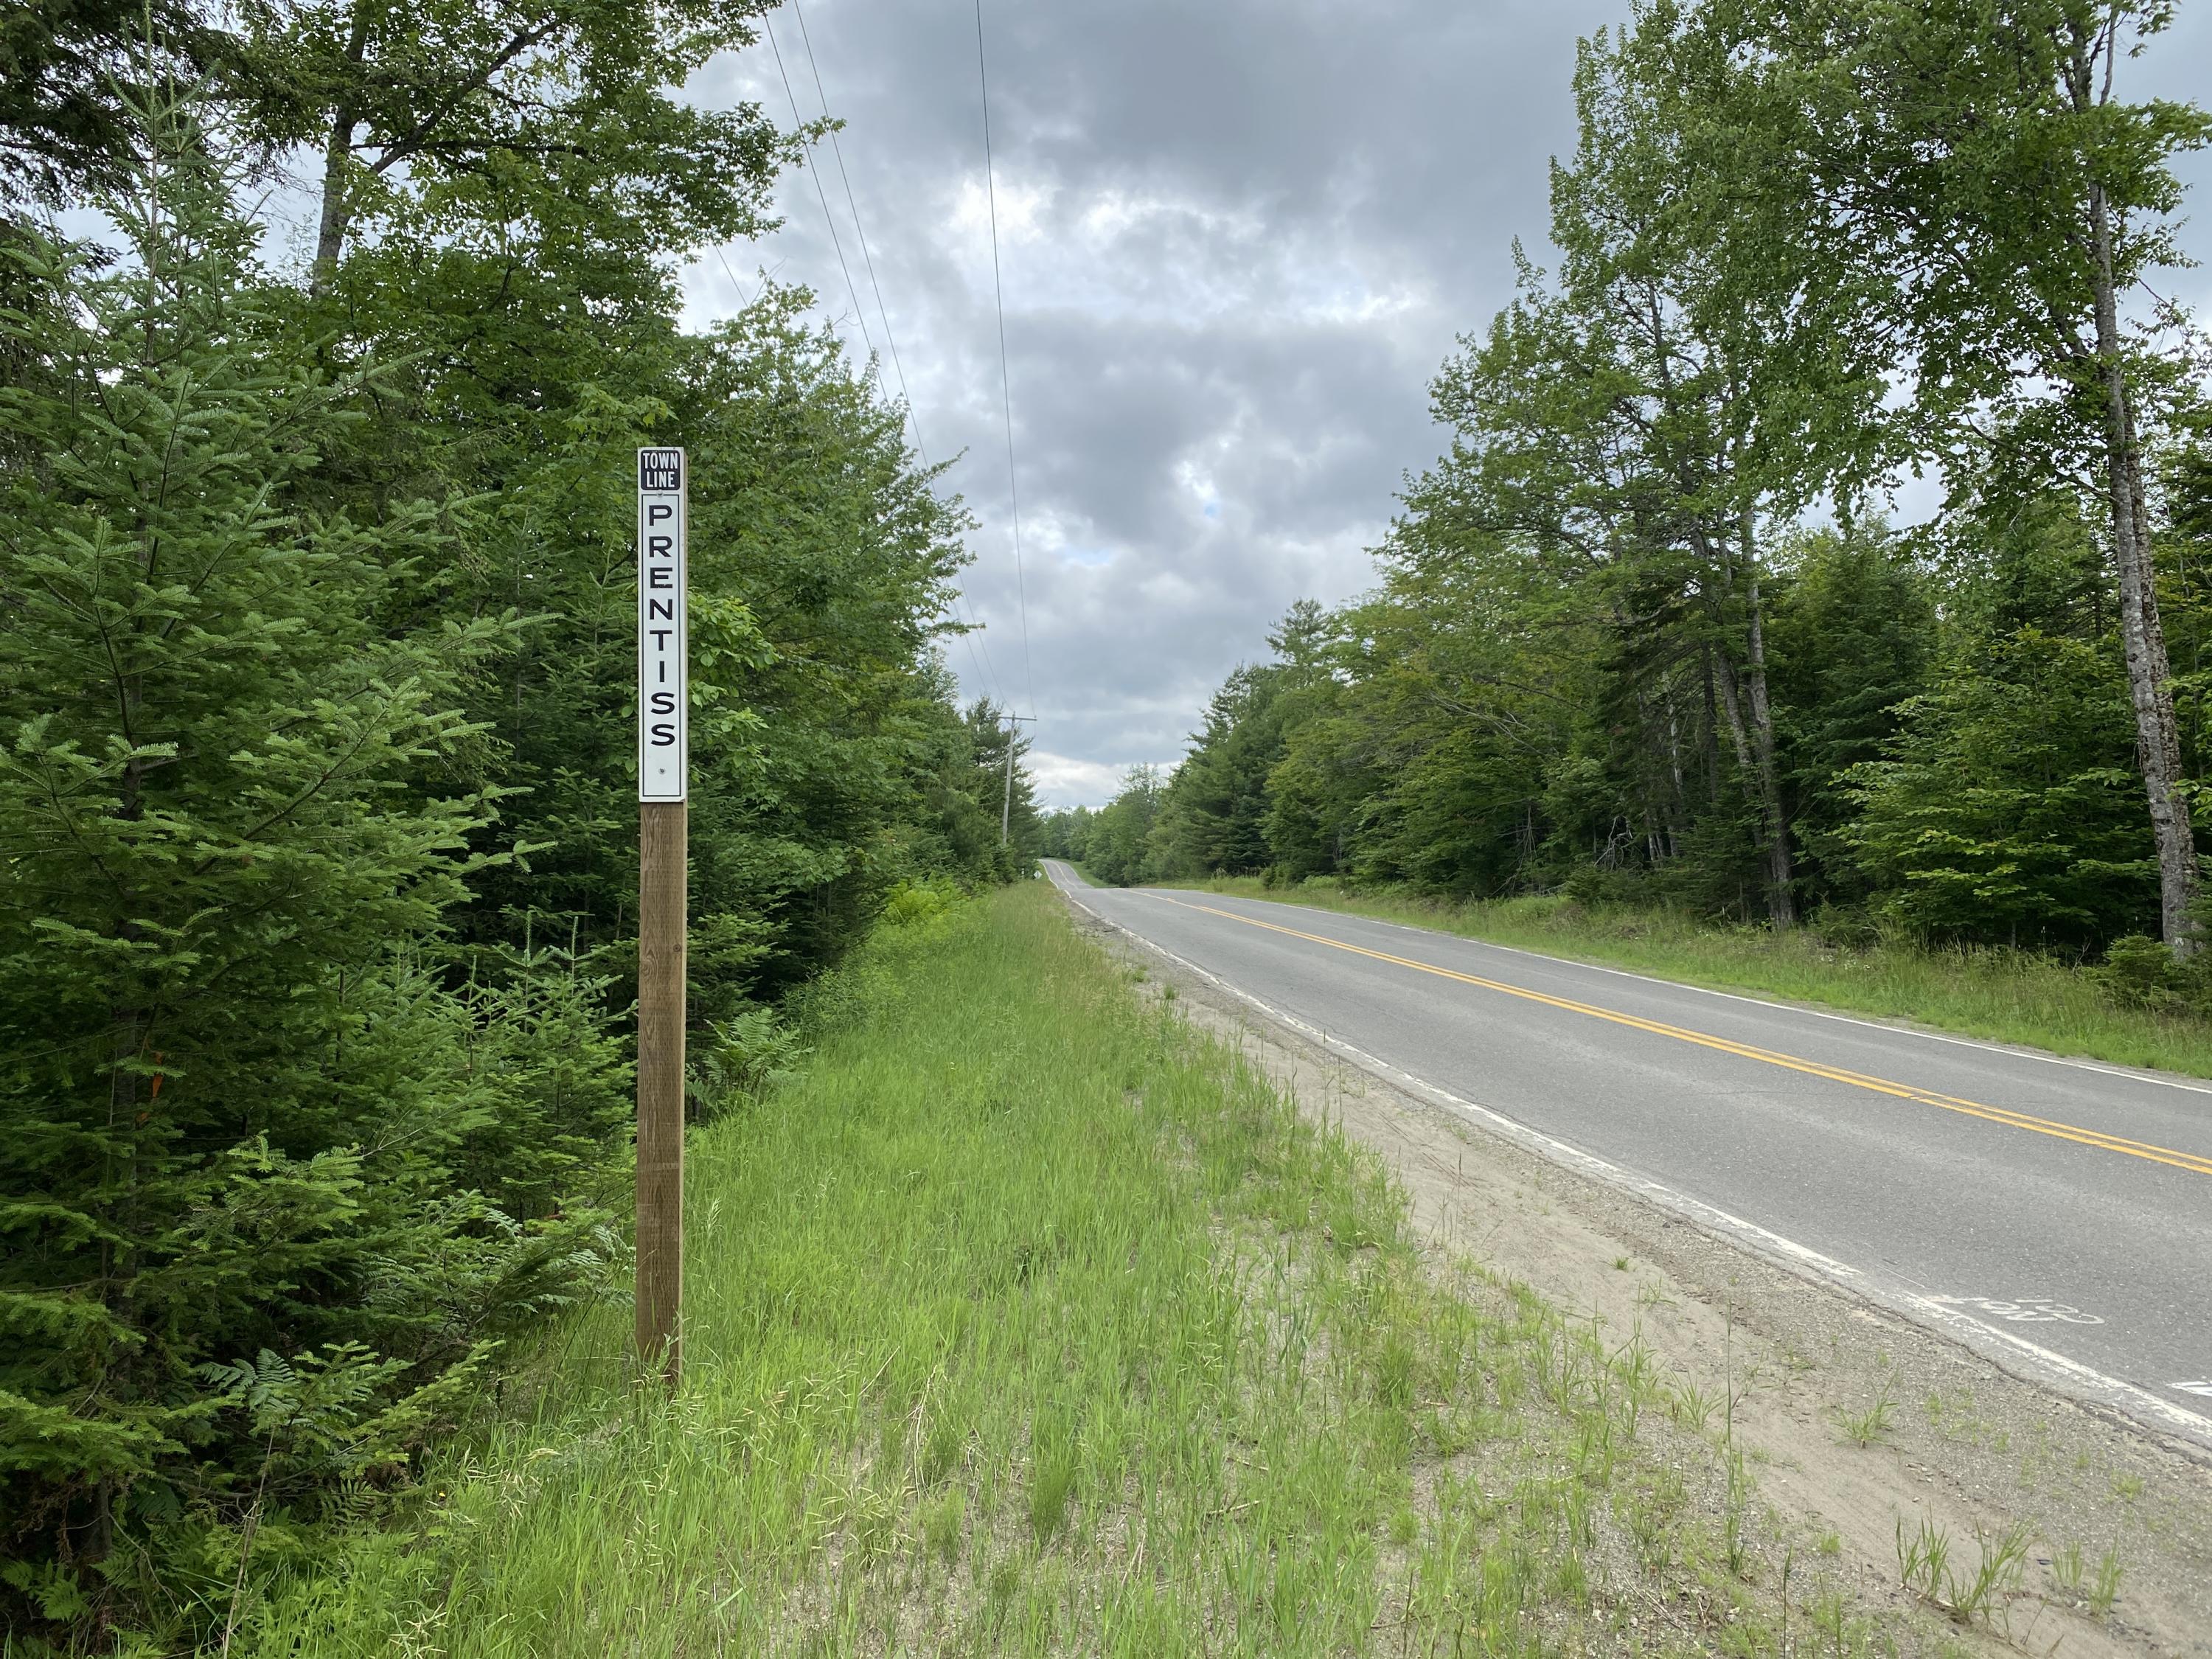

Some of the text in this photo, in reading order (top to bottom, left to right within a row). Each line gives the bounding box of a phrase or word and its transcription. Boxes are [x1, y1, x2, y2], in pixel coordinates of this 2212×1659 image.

[643, 452, 678, 469] TOWN
[646, 471, 675, 487] LINE
[649, 504, 675, 746] PRENTISS
